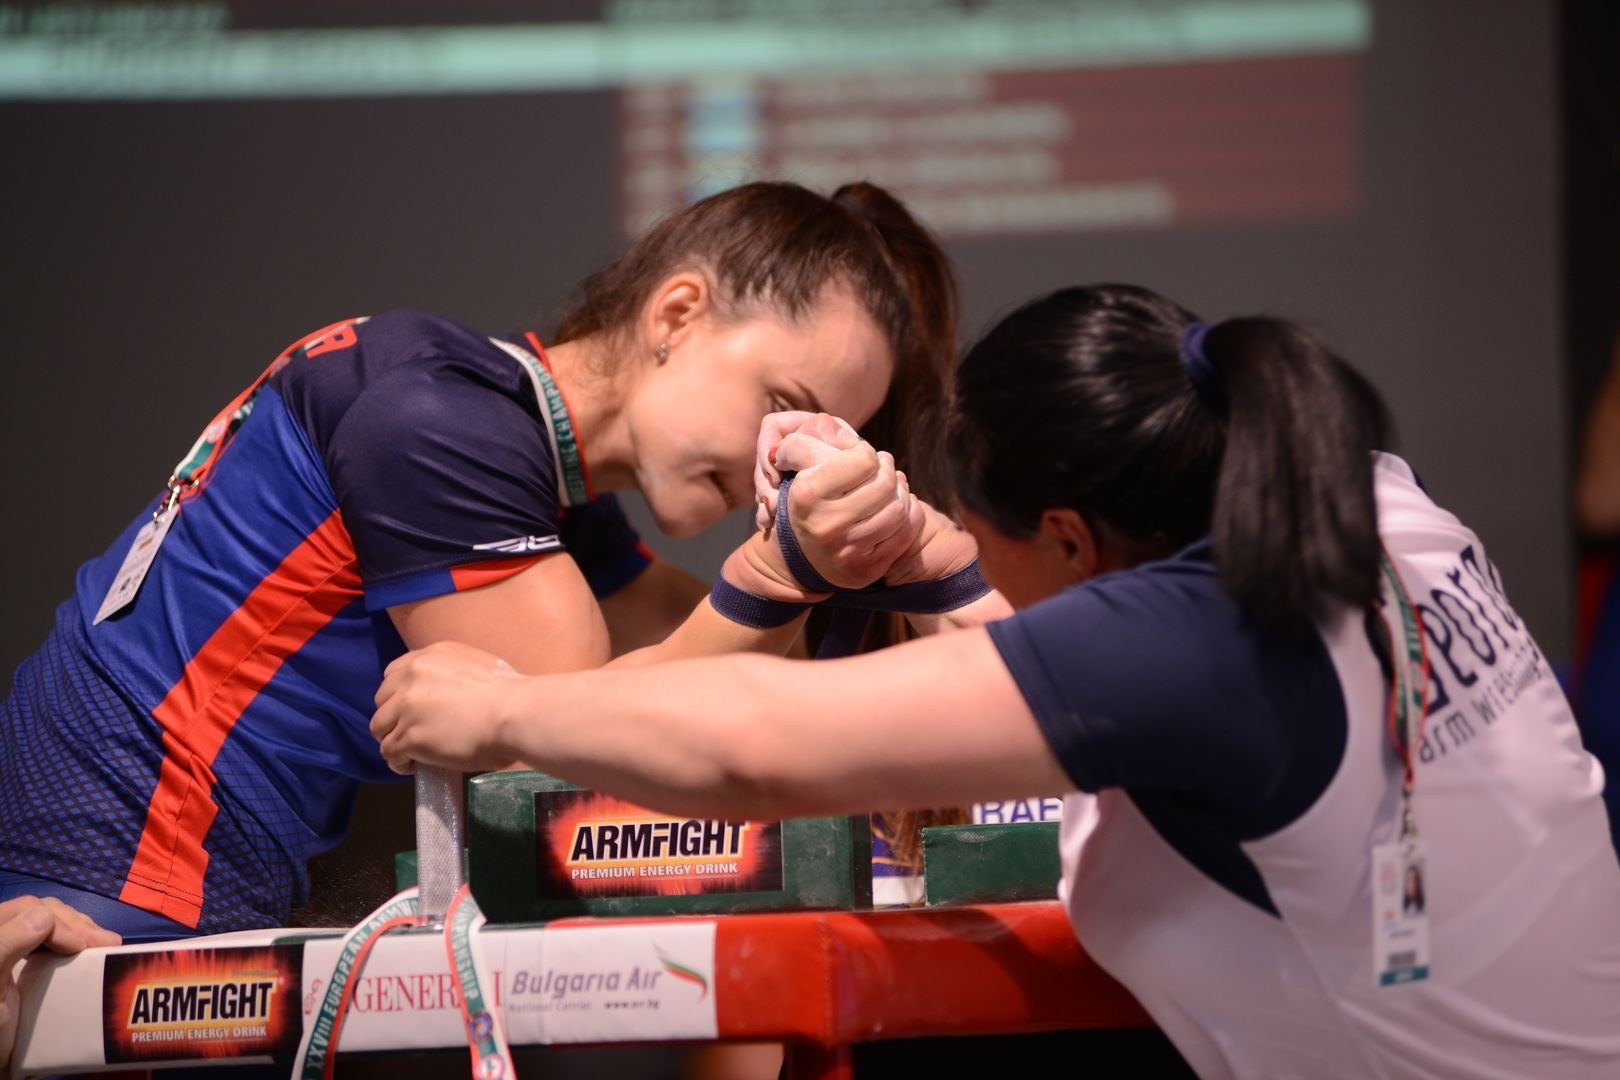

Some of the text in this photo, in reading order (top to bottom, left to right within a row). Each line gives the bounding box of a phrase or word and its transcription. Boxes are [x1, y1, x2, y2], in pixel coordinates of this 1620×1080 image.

[1419, 710, 1476, 764] arm
[570, 819, 747, 862] ARMFIGHT
[571, 862, 738, 879] PREMIUM ENERGY DRINK
[323, 931, 368, 1017] EUROPEAN
[353, 971, 503, 1013] GENERI
[511, 966, 663, 999] Bulgaria Air
[131, 982, 273, 1024] ARMFIGHT
[131, 1025, 267, 1044] PREMIUM ENERGY DRINK
